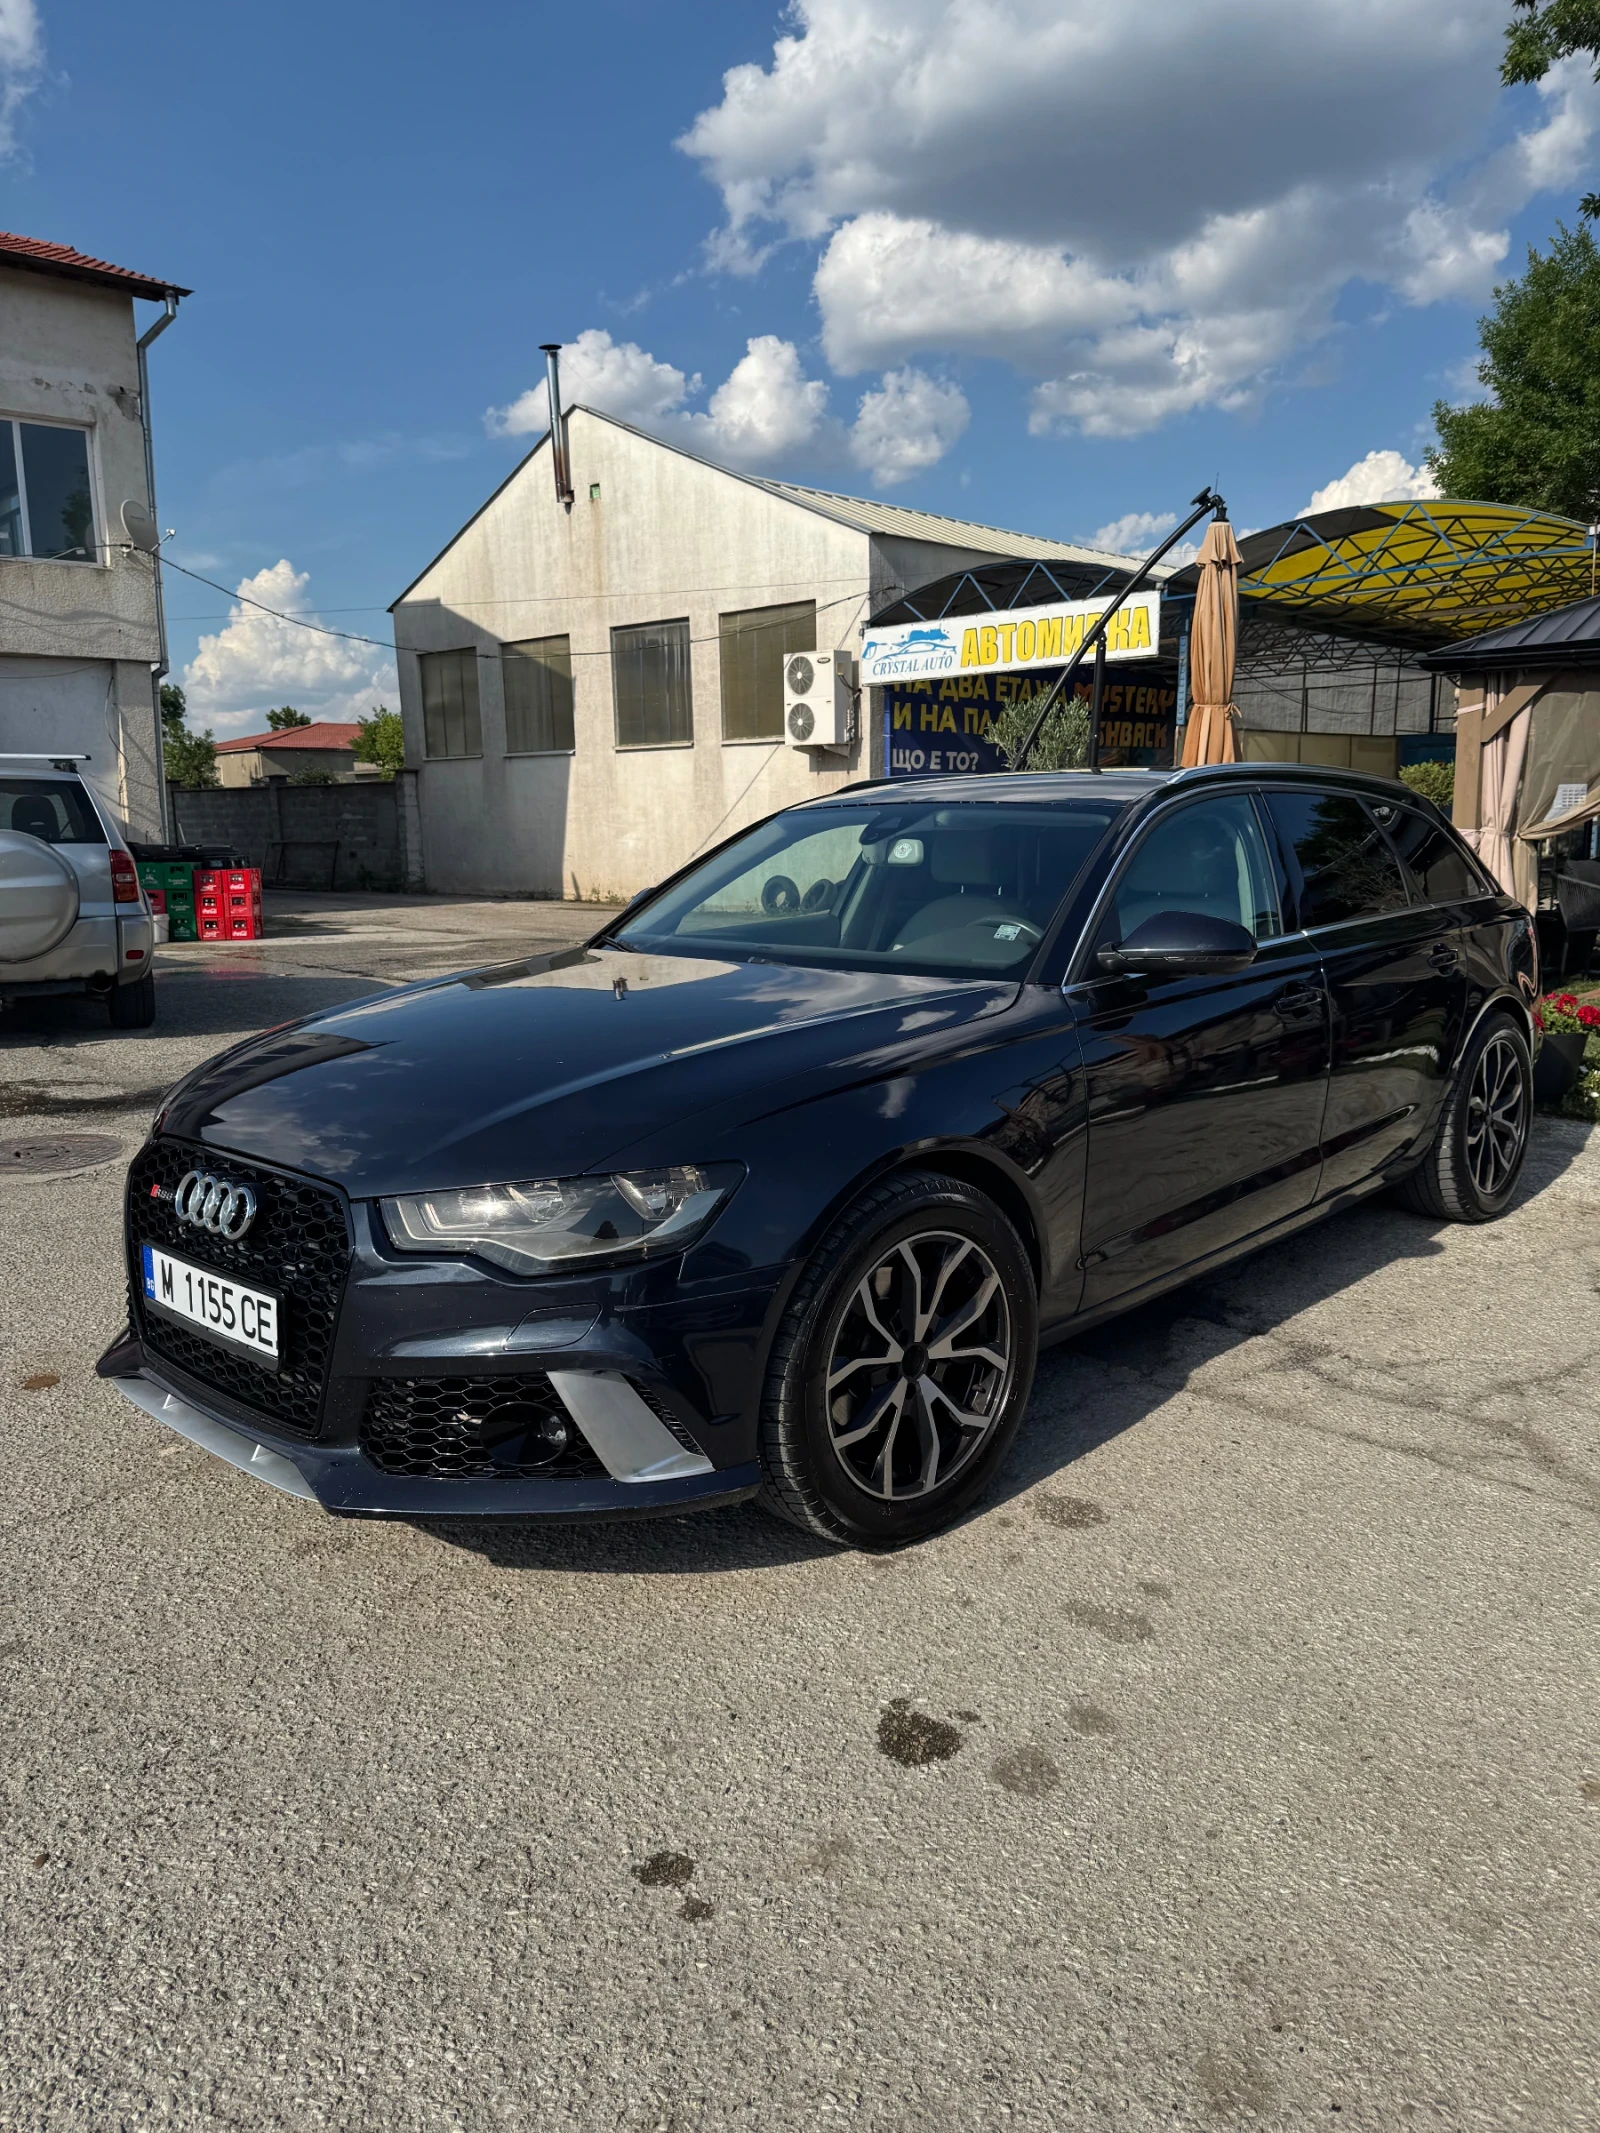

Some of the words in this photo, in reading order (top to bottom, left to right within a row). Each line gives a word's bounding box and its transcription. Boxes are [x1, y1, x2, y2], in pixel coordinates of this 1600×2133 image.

[872, 659, 919, 676] CRYSTAL
[921, 655, 953, 671] AUTO
[939, 674, 989, 702] ДВА
[893, 702, 912, 731] И
[920, 704, 958, 733] НА
[892, 748, 925, 772] ЩО
[930, 751, 941, 770] Е
[946, 751, 979, 771] ТО?
